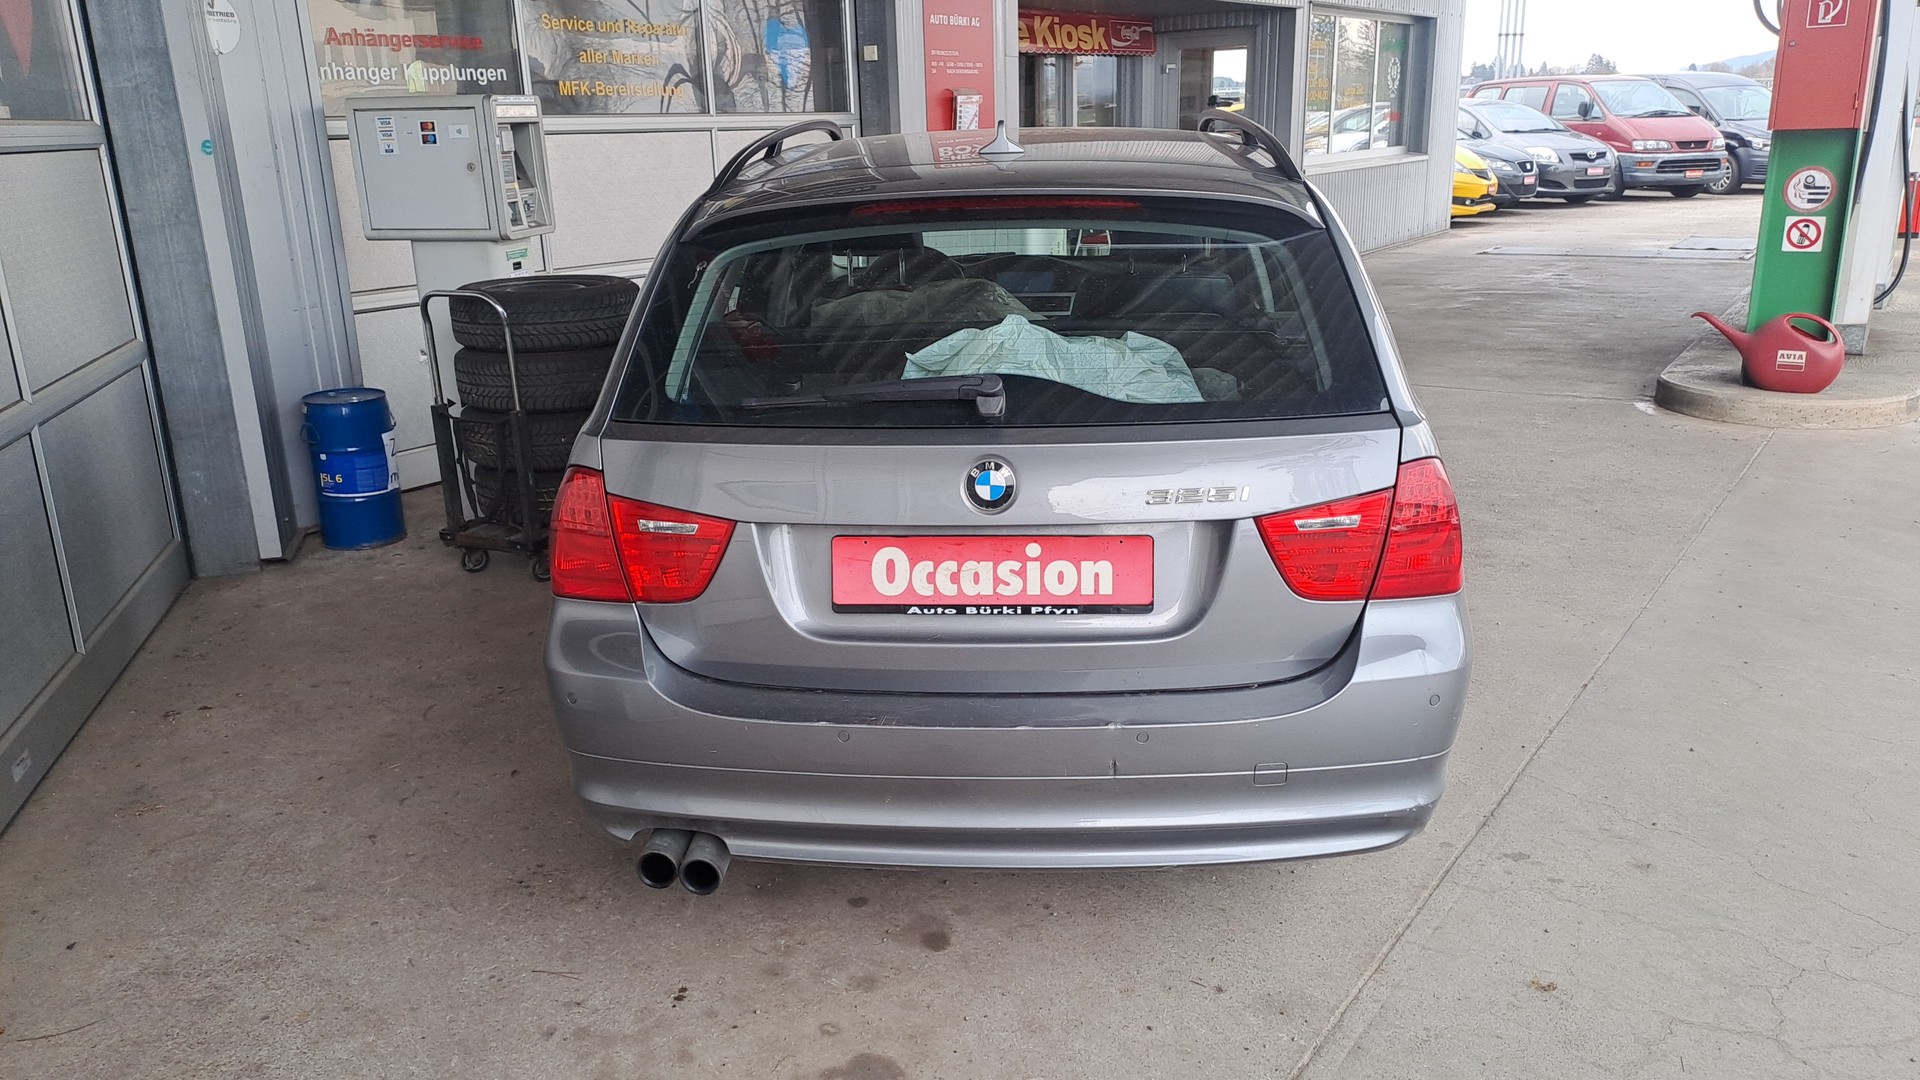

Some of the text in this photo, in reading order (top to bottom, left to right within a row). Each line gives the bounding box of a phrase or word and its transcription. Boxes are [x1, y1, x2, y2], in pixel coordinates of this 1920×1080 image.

[541, 13, 689, 37] Service und Reparatur
[930, 14, 980, 27] AUTO BÜRKI AG
[324, 27, 484, 52] Anhängerservice
[1034, 15, 1108, 50] Kiosk
[579, 48, 660, 65] aller Marken
[318, 62, 397, 85] nhänger
[558, 80, 685, 99] MFK-Bereitstellung
[335, 474, 343, 483] 6
[970, 461, 1011, 478] BMW
[870, 543, 1113, 597] Occasion
[907, 606, 1079, 615] Auto Bürki Pfyn
